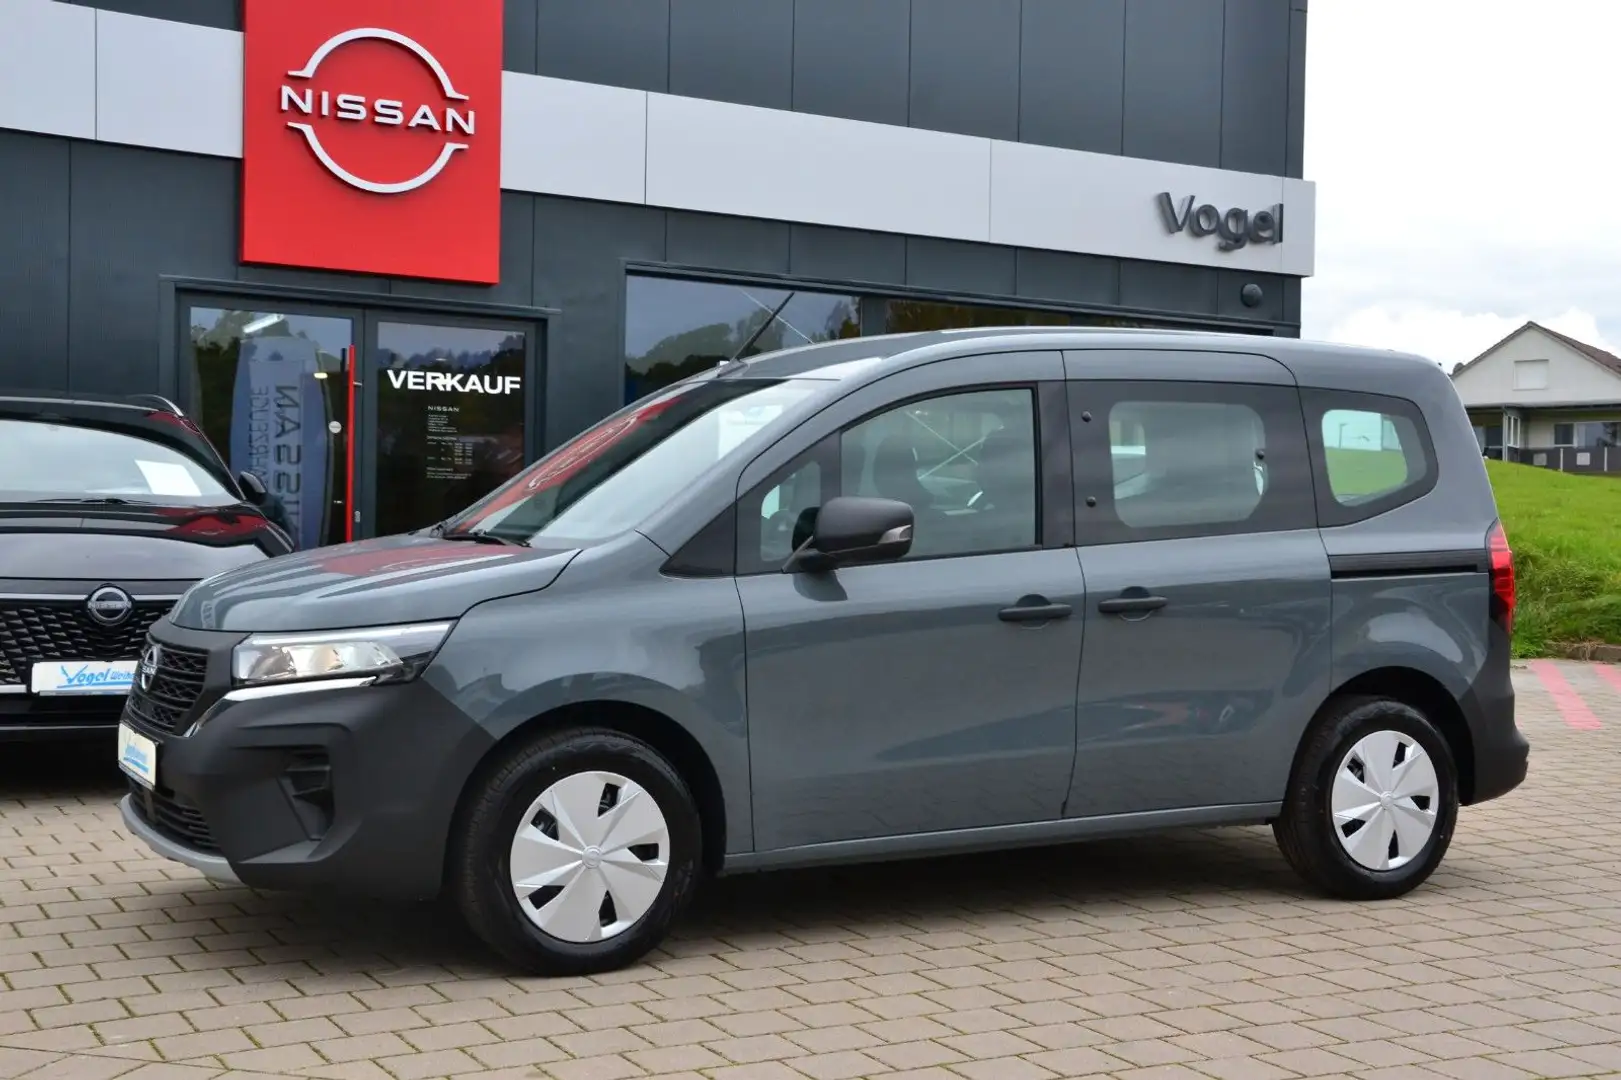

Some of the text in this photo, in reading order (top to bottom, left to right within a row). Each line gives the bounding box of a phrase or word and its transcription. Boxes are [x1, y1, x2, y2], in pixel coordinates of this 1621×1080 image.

[280, 84, 475, 135] NISSAN
[1156, 192, 1284, 251] Vogel
[386, 369, 521, 395] VERKAUF
[61, 664, 111, 685] Vogel
